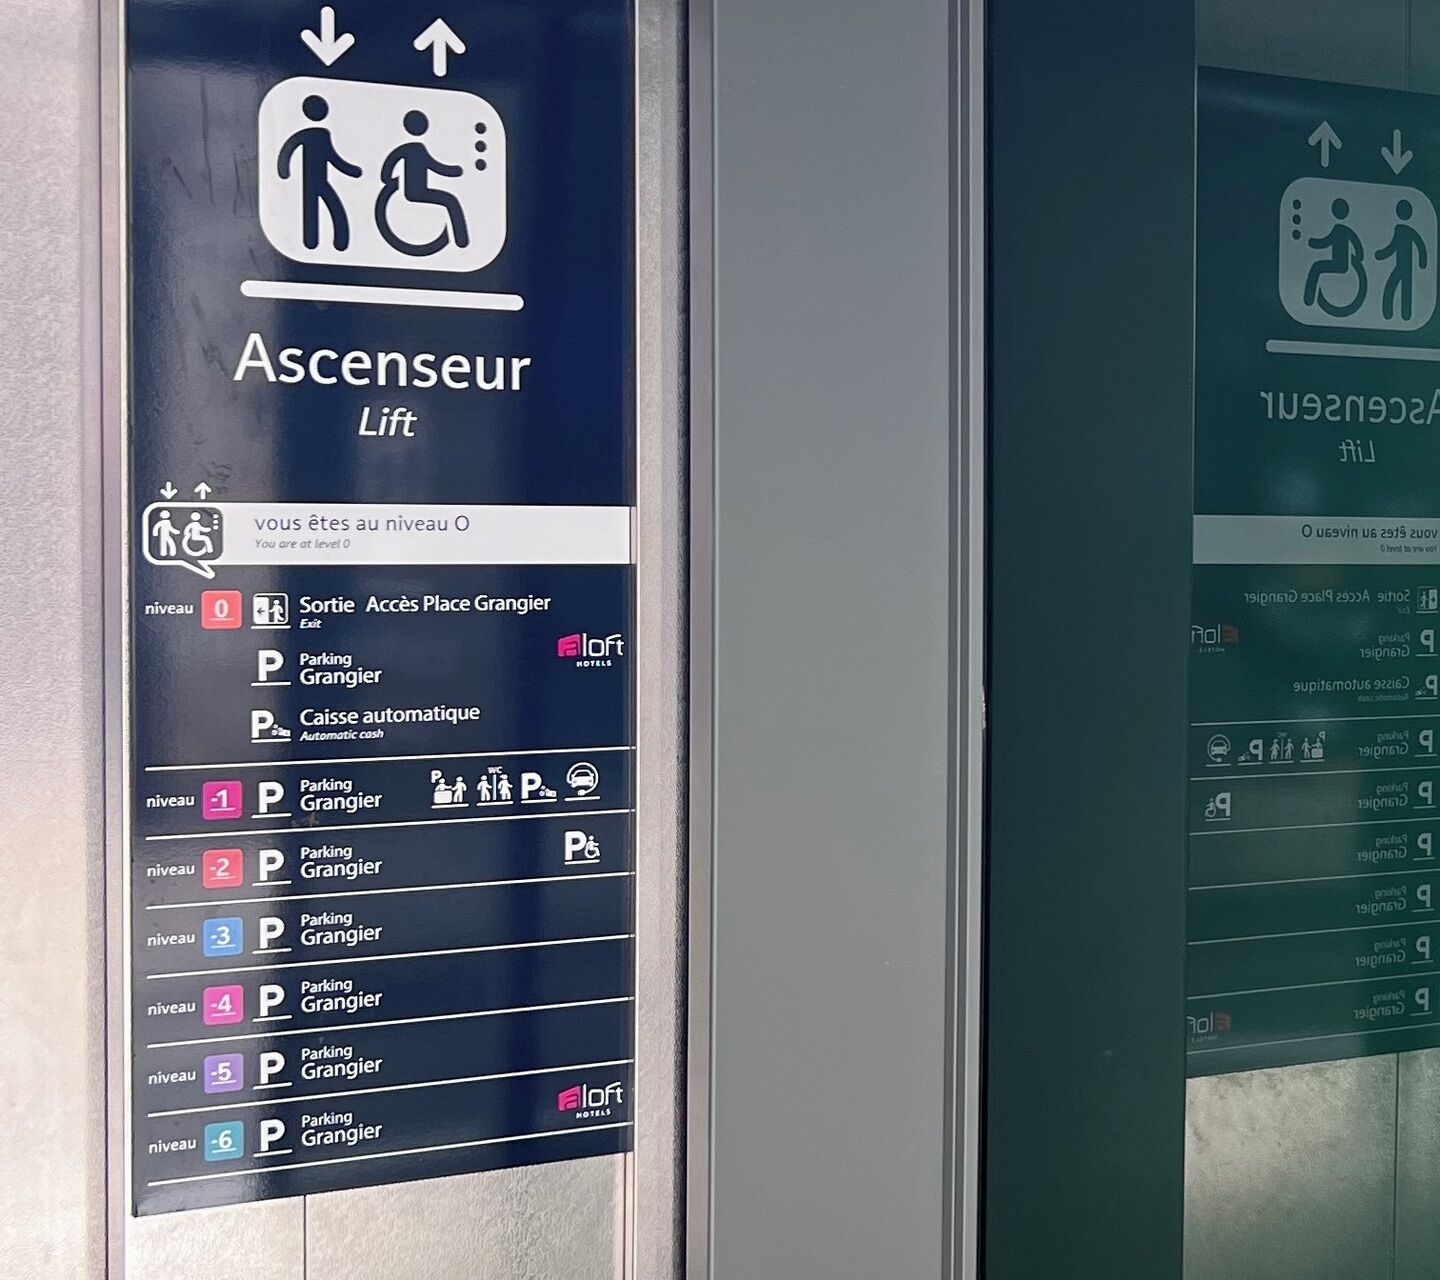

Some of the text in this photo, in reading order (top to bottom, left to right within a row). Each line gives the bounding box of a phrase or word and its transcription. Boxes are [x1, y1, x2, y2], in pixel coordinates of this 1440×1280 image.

[233, 332, 531, 391] Ascenseur
[358, 406, 418, 437] Lift
[255, 517, 301, 532] vous
[308, 513, 350, 532] êtes
[356, 517, 379, 532] au
[386, 514, 448, 532] niveau
[255, 538, 351, 549] You are at level 0
[145, 599, 229, 617] niveau 0
[300, 593, 551, 615] Sortie Accès Place Grangier
[300, 618, 322, 629] Exit
[258, 649, 284, 681] P
[300, 652, 352, 668] Parking
[576, 659, 612, 668] HOTELS
[300, 667, 382, 688] Grangier
[300, 705, 480, 727] Caisse automatique
[300, 728, 384, 741] Automatic cash
[488, 766, 503, 774] WC
[300, 778, 352, 794] Parking
[147, 790, 229, 809] niveau -1
[258, 782, 284, 813] P
[300, 793, 382, 814] Grangier
[301, 845, 352, 860] Parking
[147, 858, 230, 877] niveau -2
[259, 849, 284, 881] P
[301, 858, 383, 881] Grangier
[301, 912, 352, 927] Parking
[147, 926, 231, 946] niveau -3
[259, 917, 284, 948] P
[301, 925, 382, 946] Grangier
[301, 978, 352, 994] Parking
[148, 994, 232, 1016] niveau -4
[259, 985, 285, 1016] P
[301, 990, 382, 1013] Grangier
[301, 1044, 352, 1060] Parking
[148, 1063, 231, 1084] niveau -5
[260, 1052, 285, 1084] P
[301, 1057, 382, 1080] Grangier
[301, 1111, 352, 1126] Parking
[576, 1108, 611, 1119] HOTELS
[149, 1130, 232, 1152] niveau -6
[260, 1119, 285, 1151] P
[301, 1123, 382, 1147] Grangier
